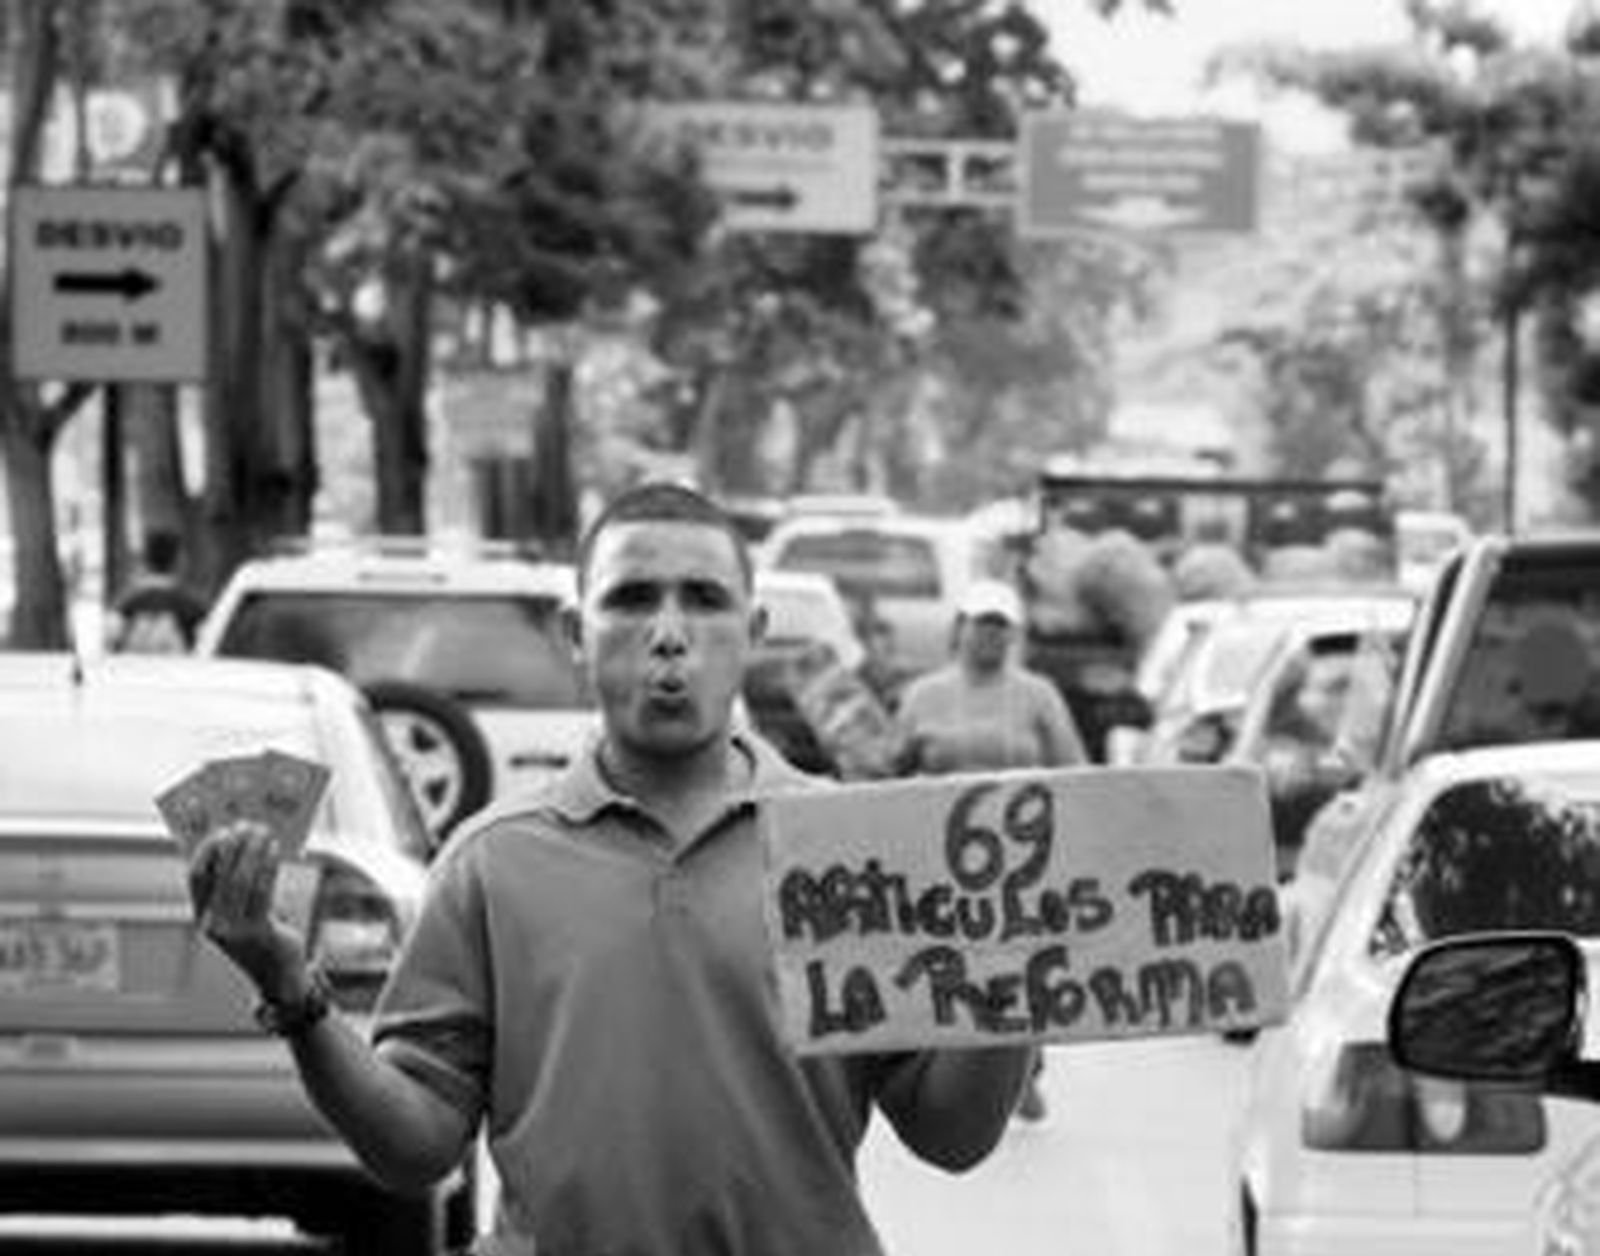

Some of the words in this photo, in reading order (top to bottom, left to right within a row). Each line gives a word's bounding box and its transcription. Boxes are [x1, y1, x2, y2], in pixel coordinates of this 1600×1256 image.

[36, 220, 184, 250] DESVIO
[945, 782, 1055, 890] 69
[1128, 868, 1281, 946] PARA
[807, 960, 887, 1037] LA
